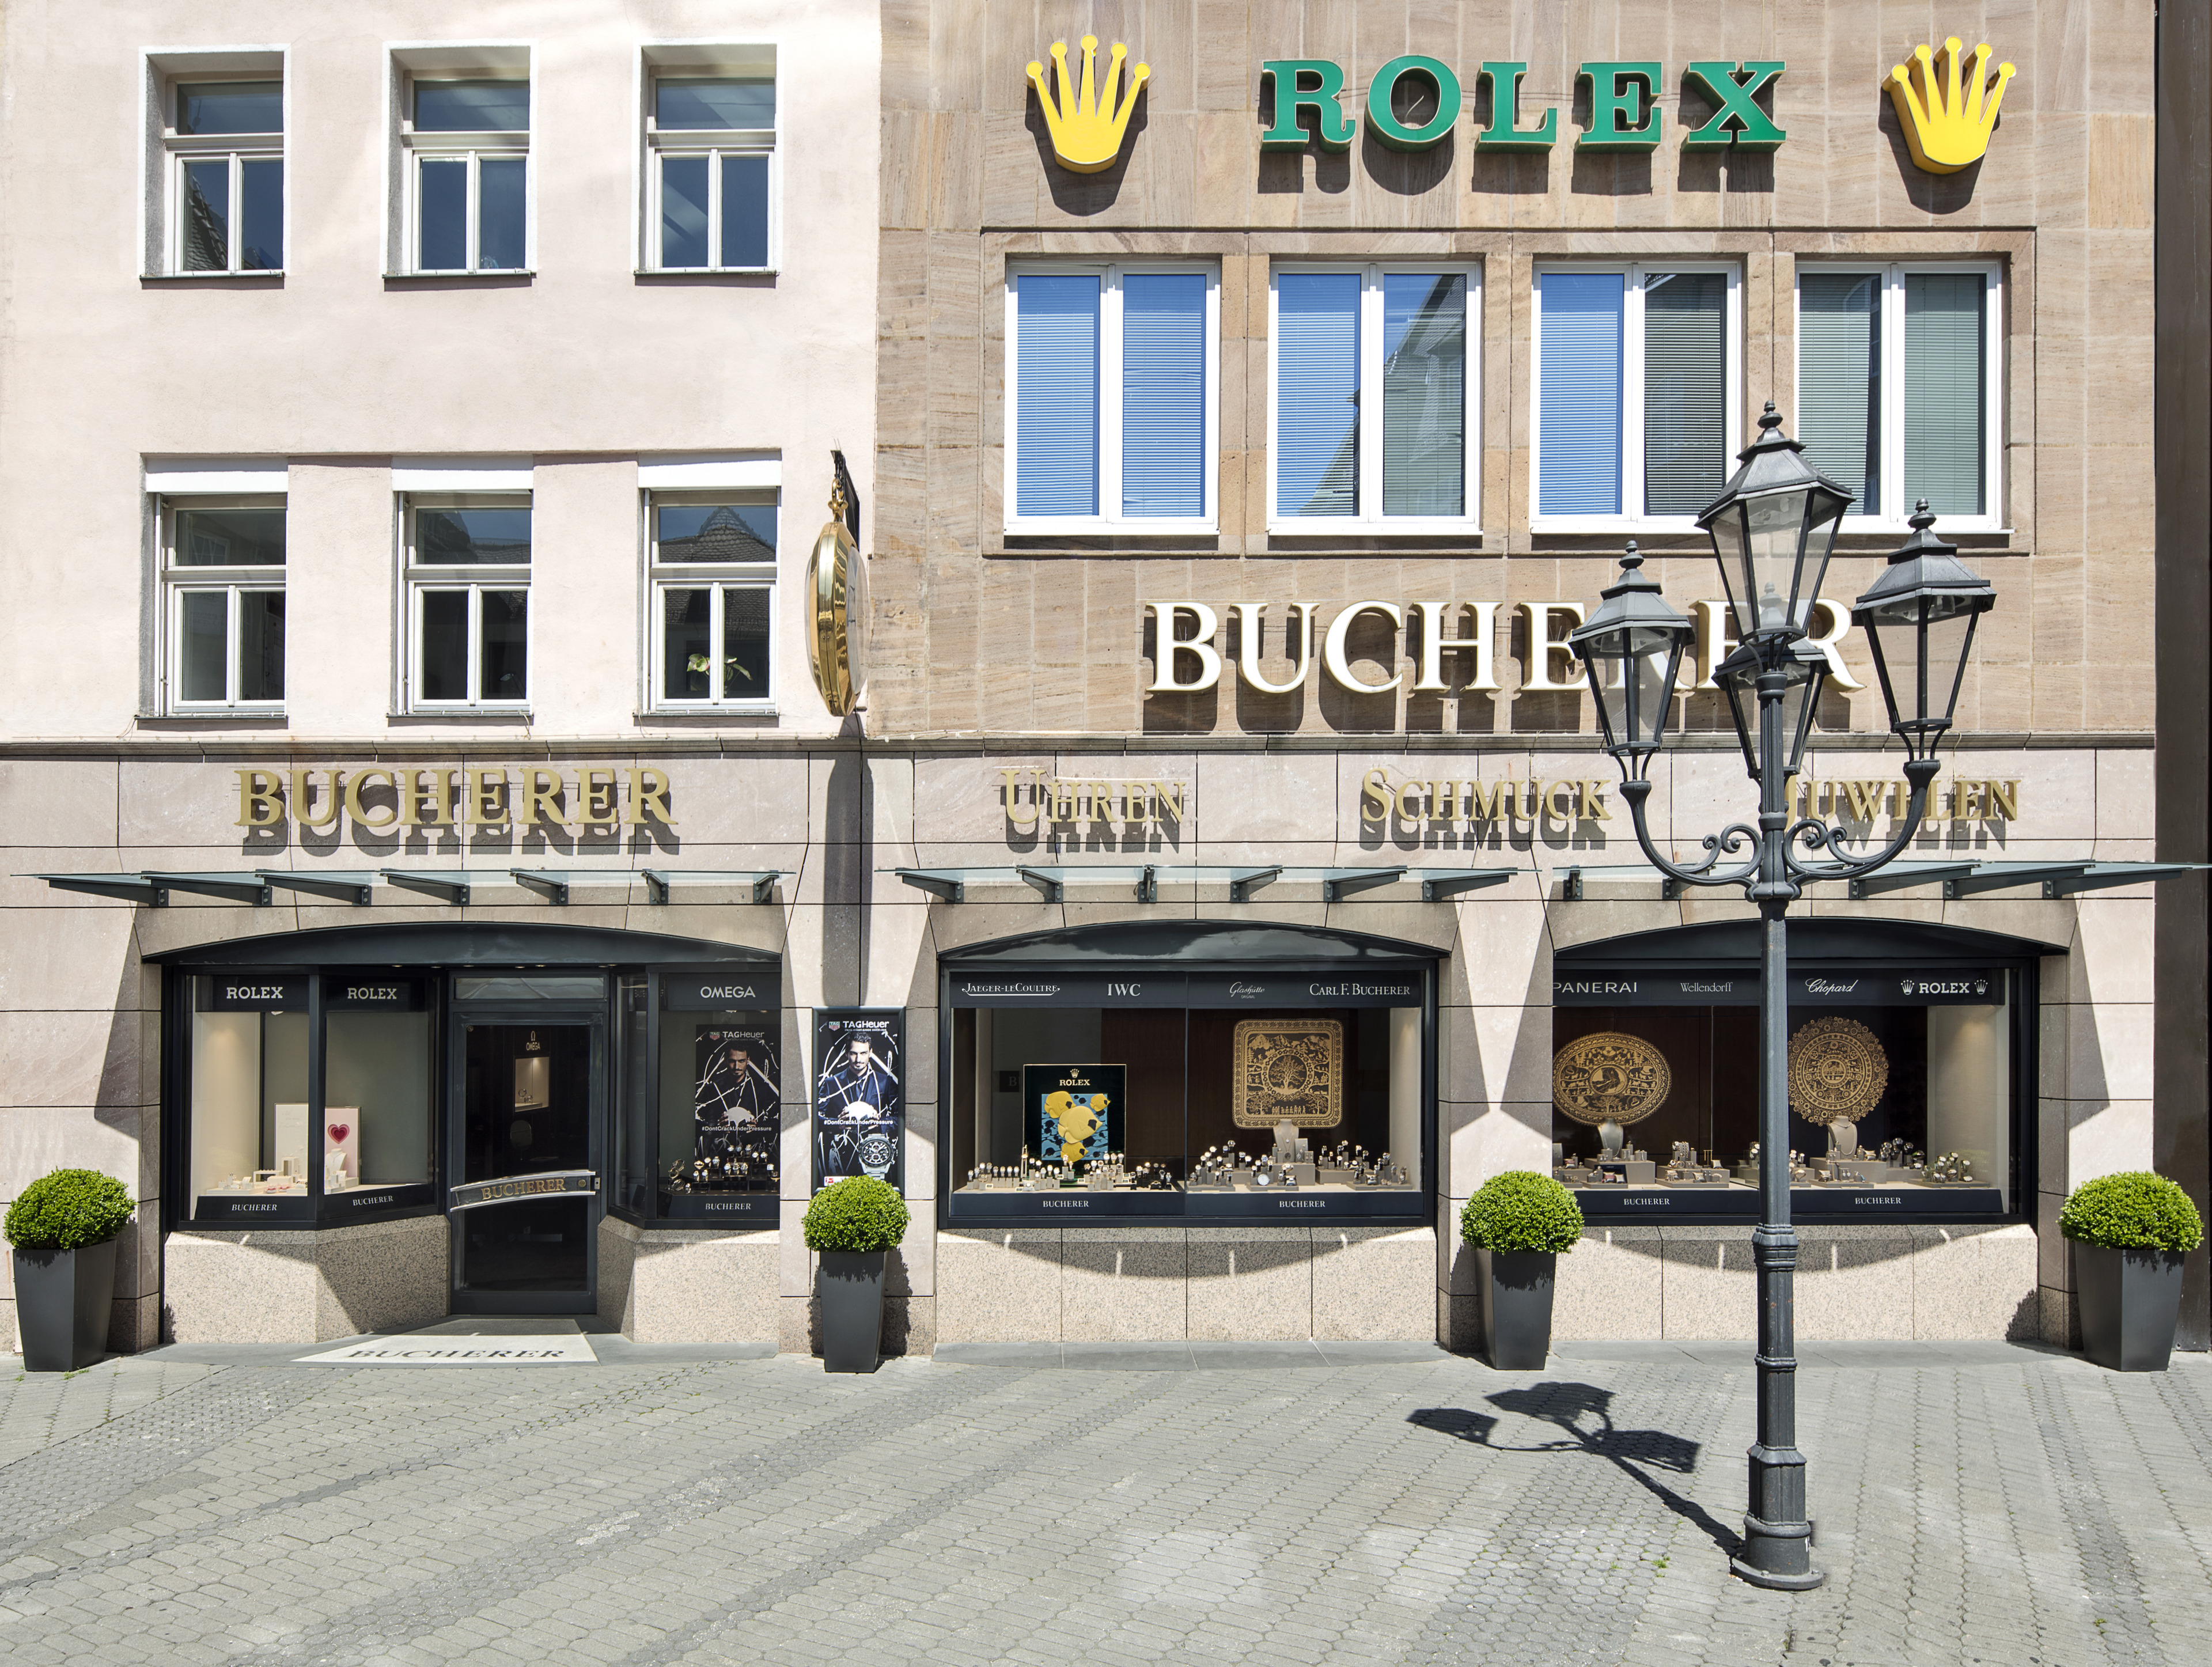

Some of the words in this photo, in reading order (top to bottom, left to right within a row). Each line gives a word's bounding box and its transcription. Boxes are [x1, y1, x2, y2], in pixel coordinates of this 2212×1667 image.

[1261, 55, 1787, 154] ROLEX
[234, 767, 679, 827] BUCHERER
[1001, 770, 1186, 824] UHREN
[1362, 768, 1613, 823] SCHMUCK
[226, 987, 283, 999] ROLEX
[700, 986, 756, 998] OMEGA
[1107, 983, 1141, 997] IWC
[1229, 982, 1265, 997] Glashütte
[1309, 983, 1339, 995] CARL
[1341, 983, 1350, 995] F.
[1353, 983, 1410, 995] BUCHERER
[1680, 982, 1733, 992] Wellendorff
[1805, 979, 1858, 995] Chopard
[1919, 983, 1969, 994] ROLEX
[347, 988, 397, 999] ROLEX
[526, 1042, 540, 1051] OMEGA
[481, 1179, 566, 1200] BUCHERER
[353, 1195, 393, 1206] BUCHERER
